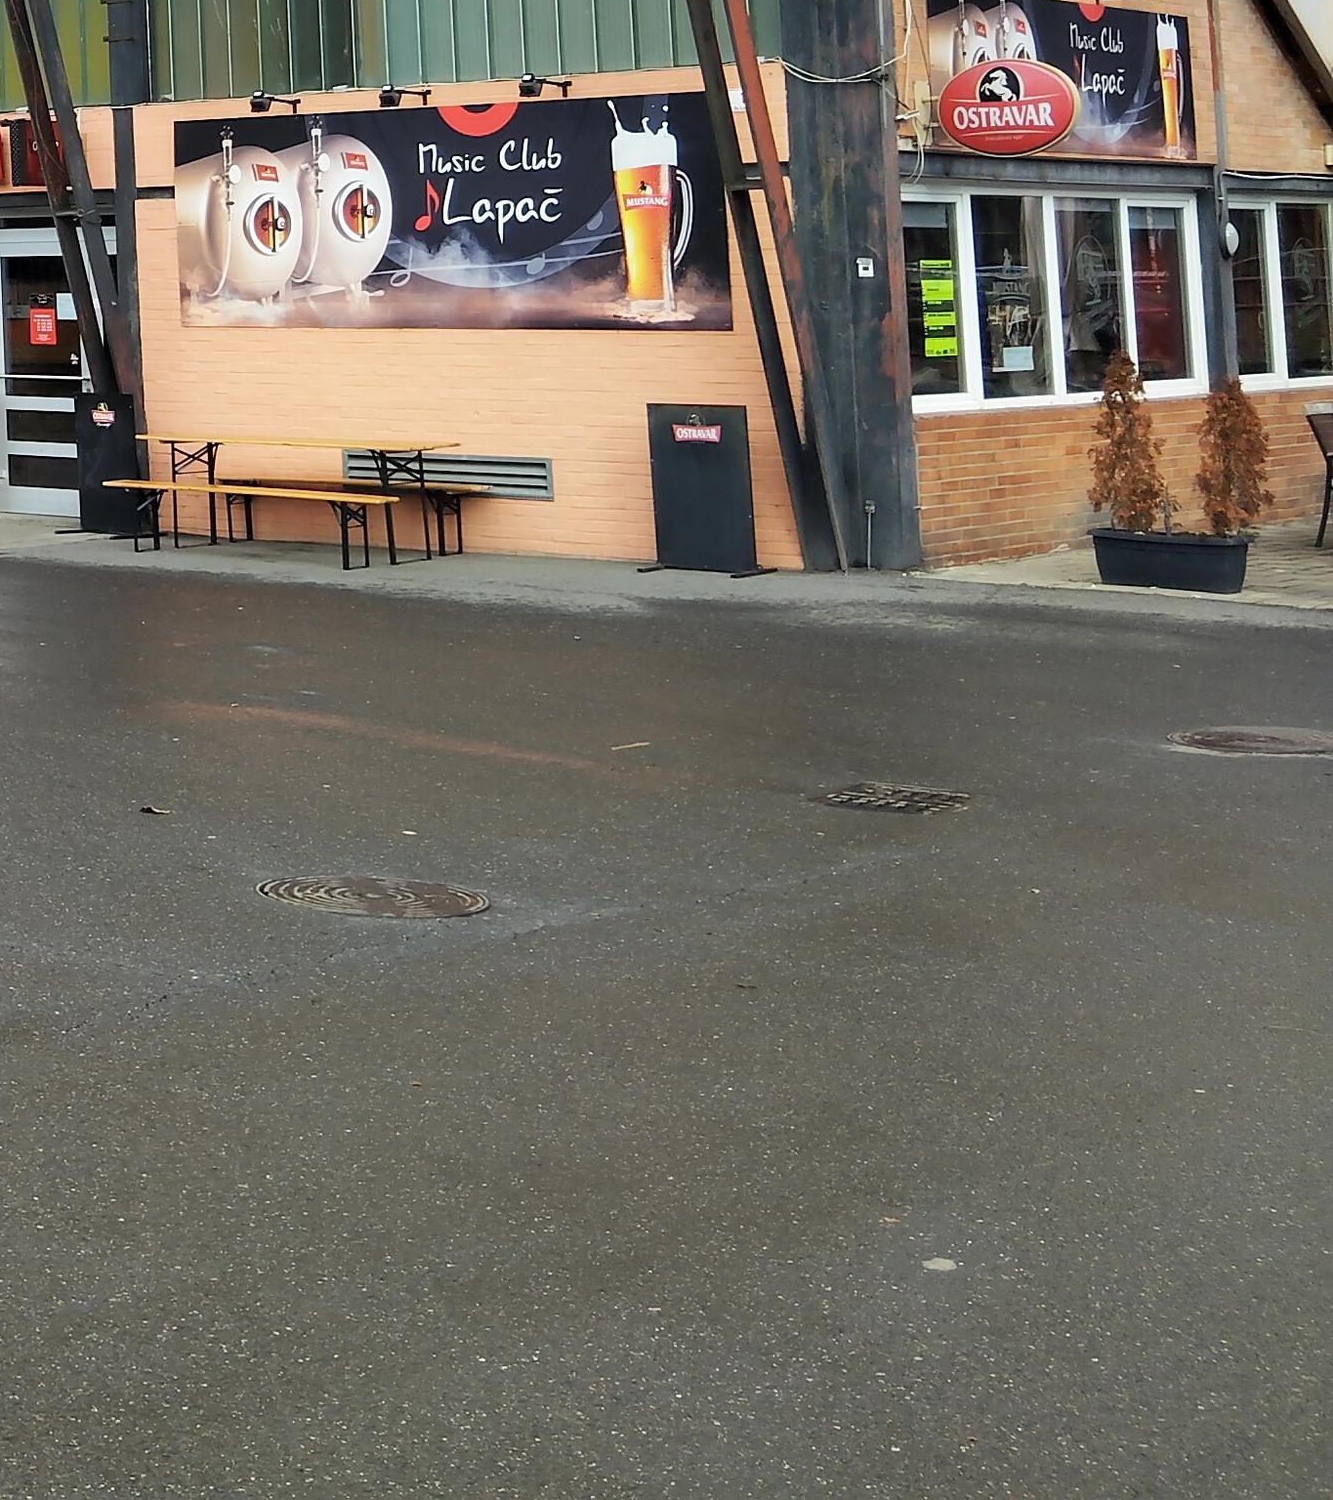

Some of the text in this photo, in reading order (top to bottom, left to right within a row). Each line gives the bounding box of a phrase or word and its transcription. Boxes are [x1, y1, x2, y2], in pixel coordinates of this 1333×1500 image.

[1068, 21, 1124, 54] Music Club
[1081, 53, 1126, 109] Lapač
[953, 102, 1055, 130] OSTRAVAR
[418, 137, 563, 174] Music Club
[442, 177, 564, 244] Lapač
[626, 196, 669, 207] MUSTANG
[676, 427, 718, 440] OSTRAVAR
